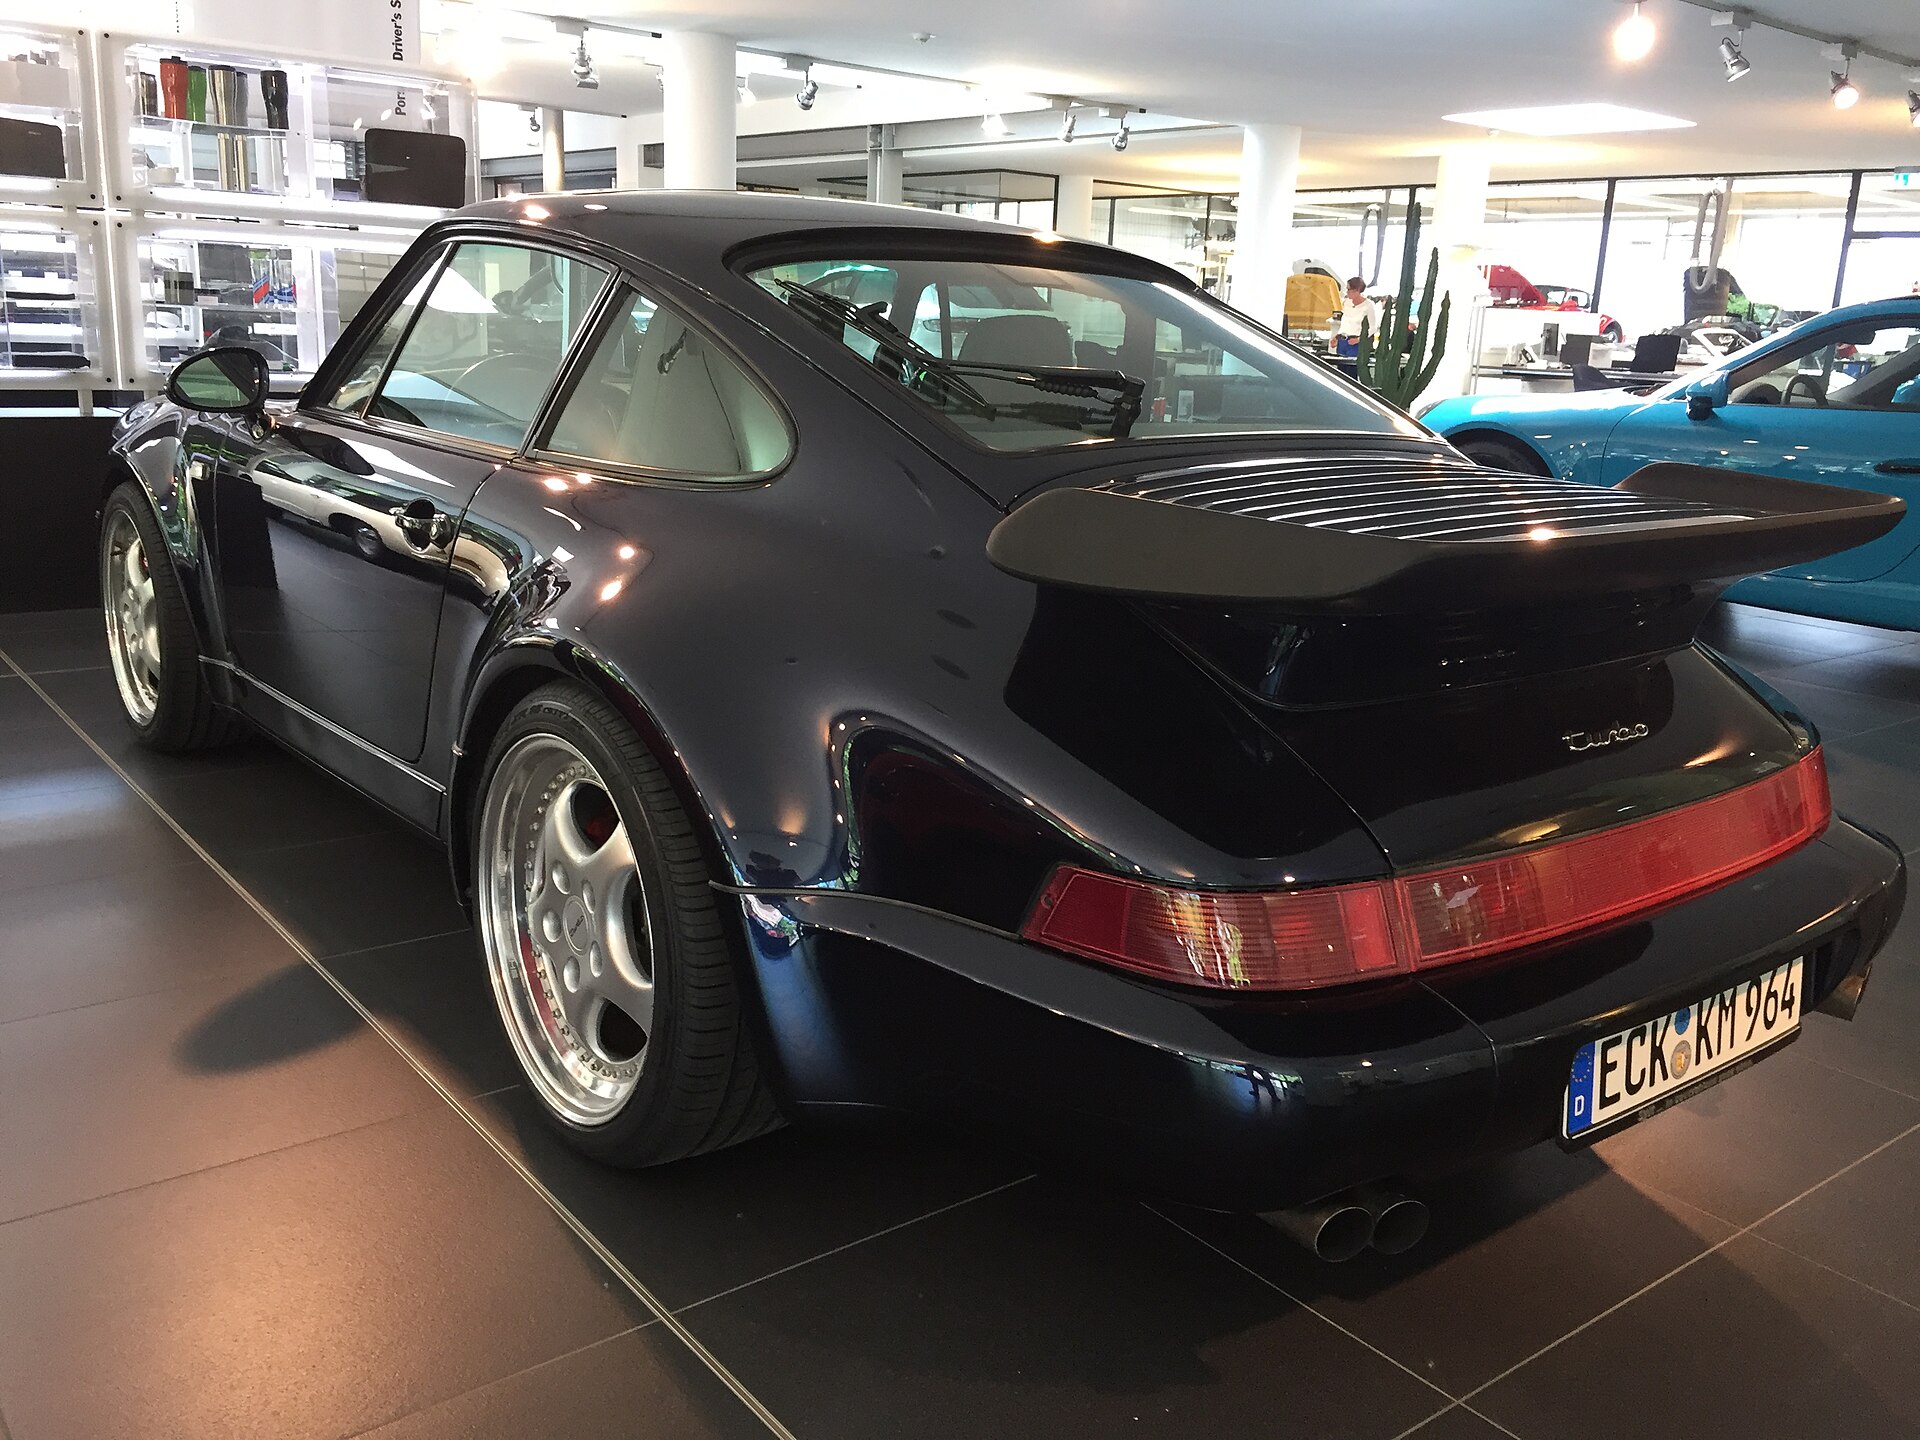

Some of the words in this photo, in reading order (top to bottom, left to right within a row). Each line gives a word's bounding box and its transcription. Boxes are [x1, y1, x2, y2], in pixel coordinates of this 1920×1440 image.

[392, 12, 402, 61] Driver's
[395, 91, 406, 116] Por
[1599, 1014, 1671, 1109] ECK
[1695, 987, 1736, 1065] KM
[1745, 960, 1795, 1041] 964
[1574, 1095, 1585, 1117] D
